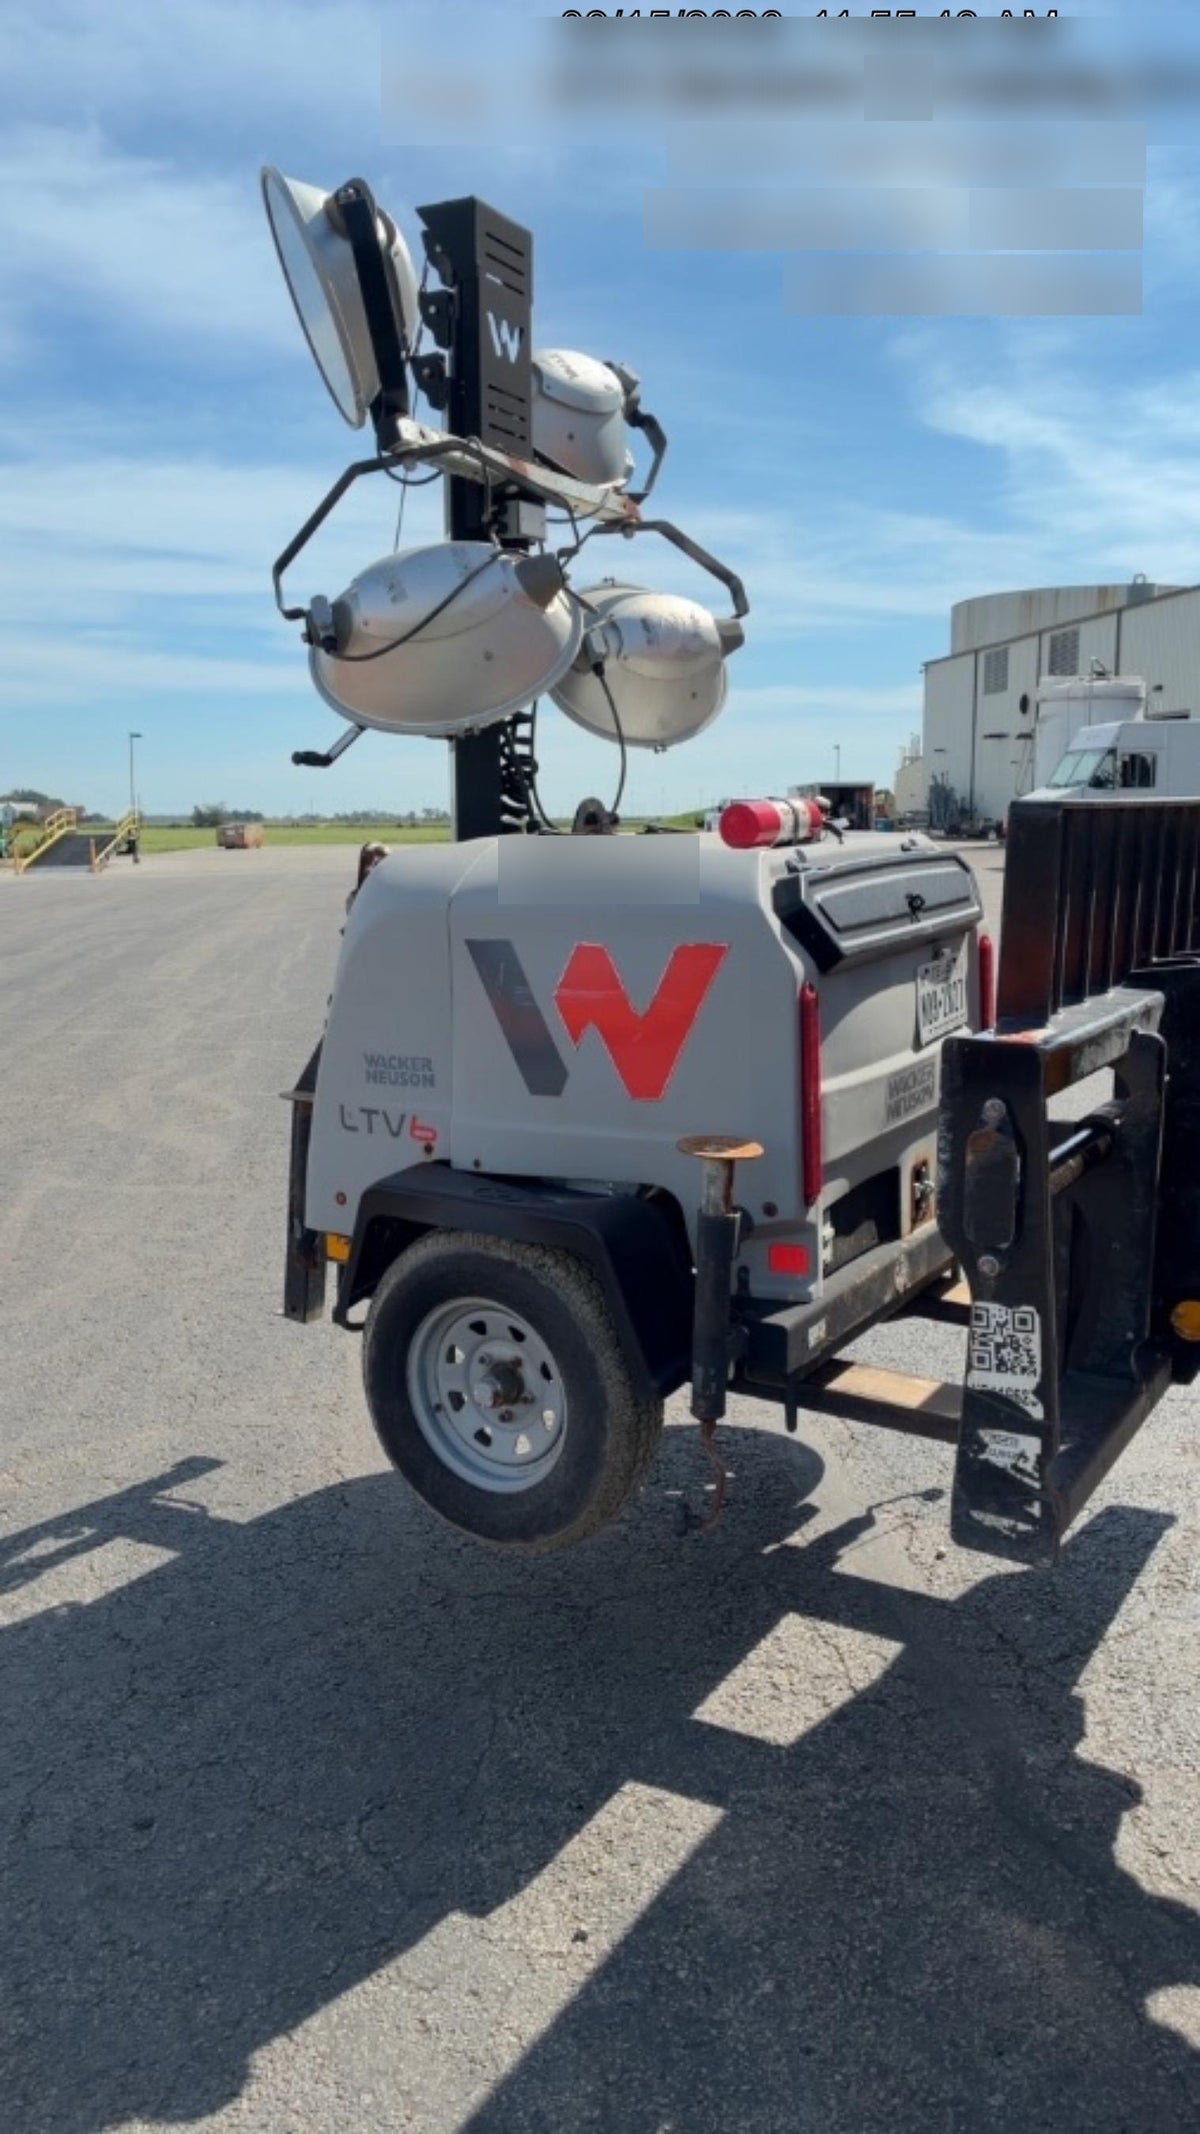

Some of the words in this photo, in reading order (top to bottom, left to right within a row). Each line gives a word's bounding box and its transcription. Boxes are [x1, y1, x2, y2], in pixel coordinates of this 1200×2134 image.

[363, 1053, 433, 1073] WACKER
[366, 1069, 435, 1088] NEUSON
[887, 1062, 936, 1098] WACKER
